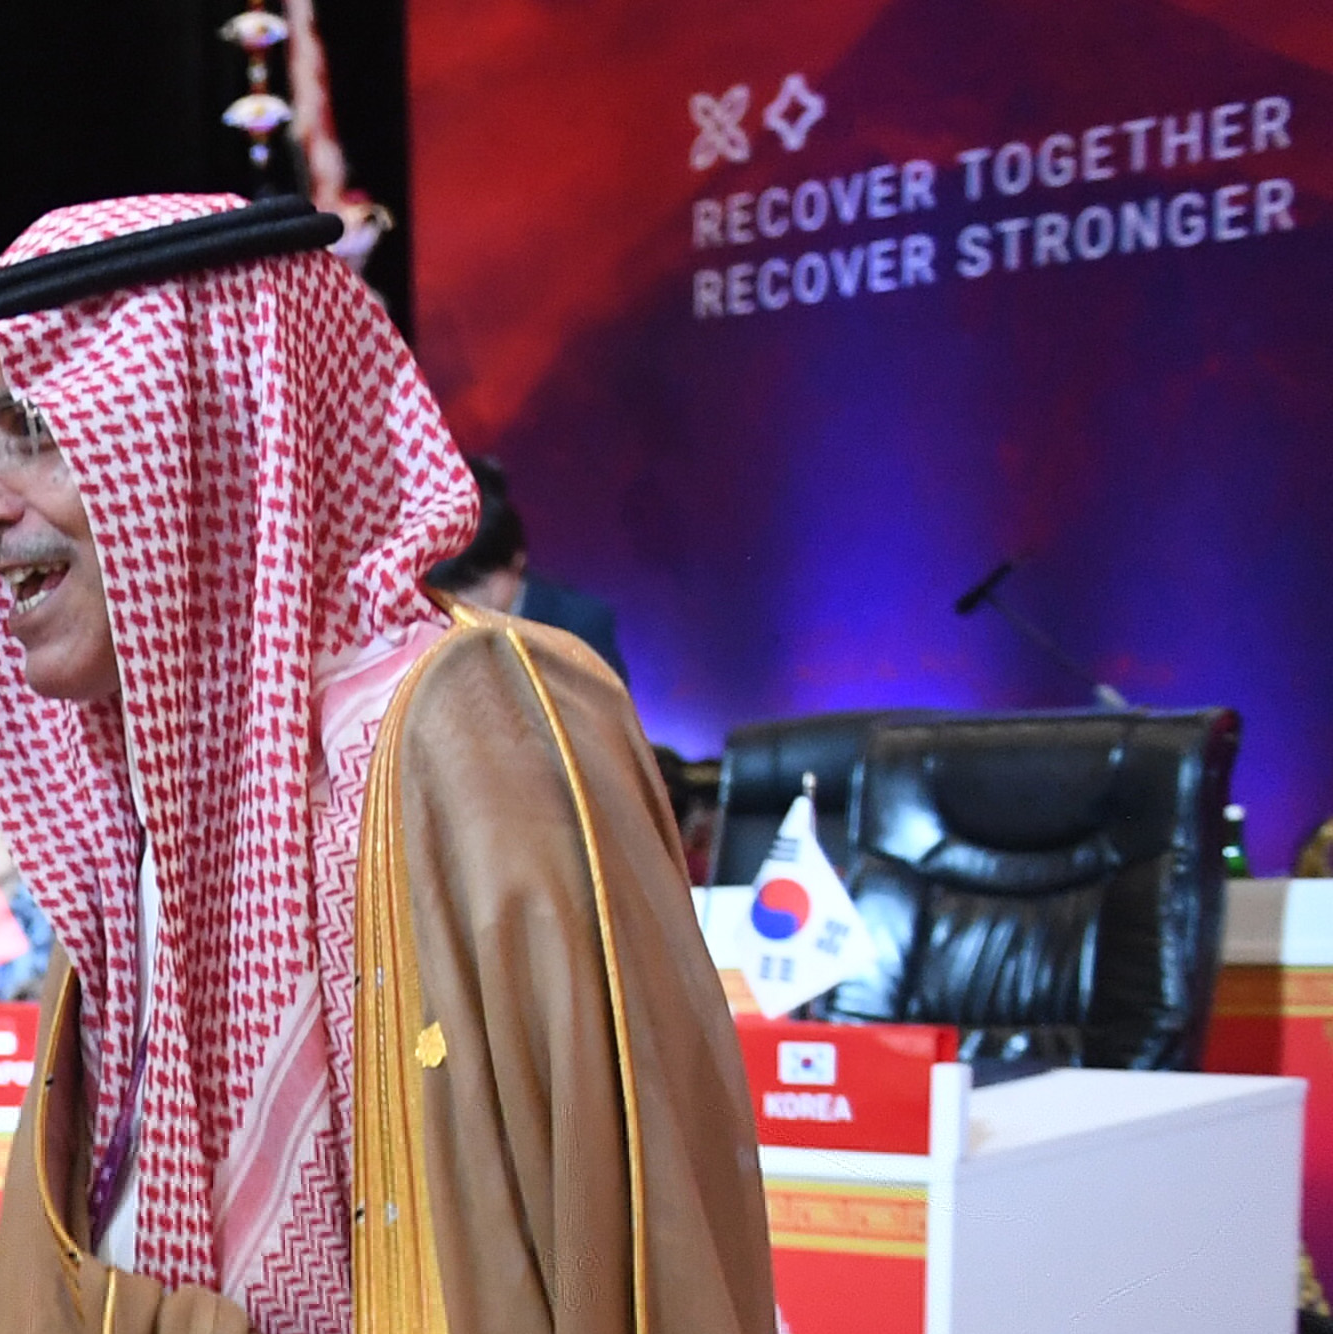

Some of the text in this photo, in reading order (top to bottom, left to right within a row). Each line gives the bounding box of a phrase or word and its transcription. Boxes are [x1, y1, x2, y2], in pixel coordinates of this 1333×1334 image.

[692, 95, 1293, 249] RECOVER TOGETHER
[692, 178, 1296, 320] RECOVER STRONGER
[762, 1091, 853, 1122] KOREA
